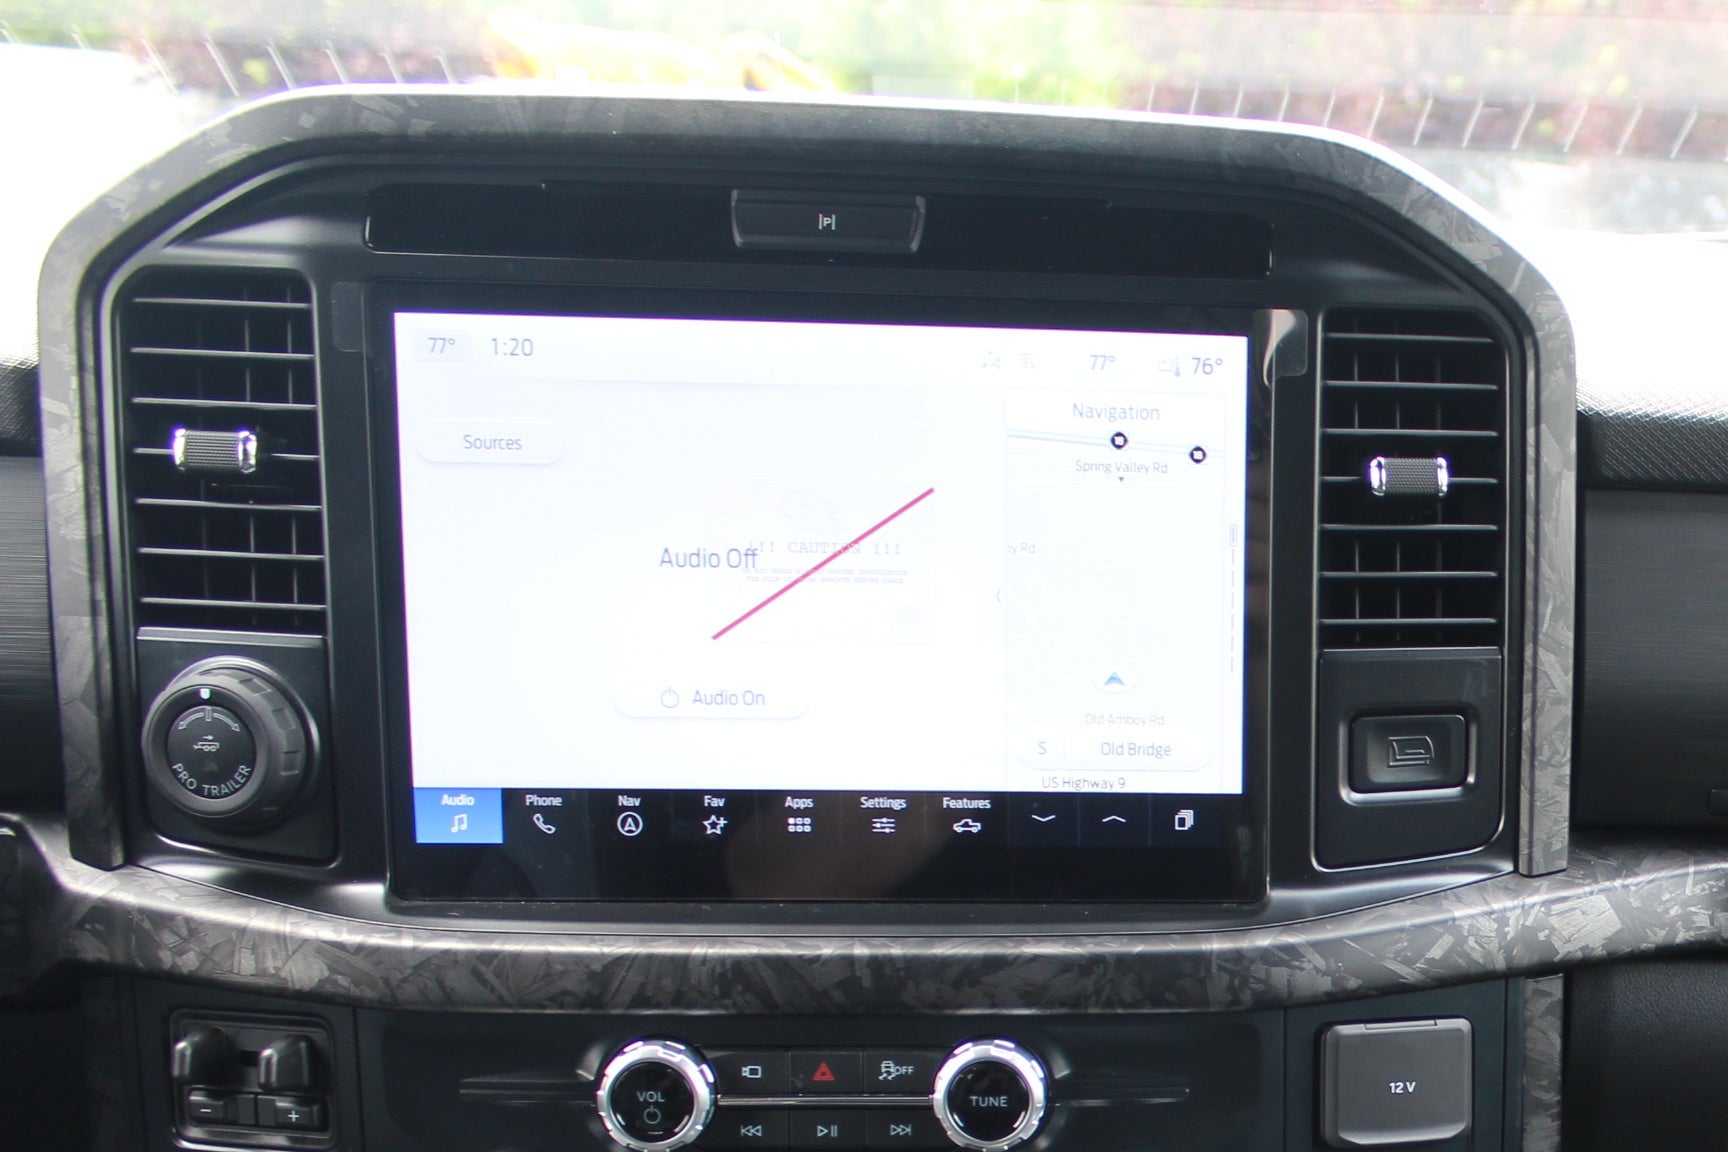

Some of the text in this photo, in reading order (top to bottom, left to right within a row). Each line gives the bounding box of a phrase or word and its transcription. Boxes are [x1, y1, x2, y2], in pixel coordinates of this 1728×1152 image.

[427, 336, 456, 354] 77°
[490, 337, 534, 357] 1:20
[1088, 353, 1116, 371] 77°
[1191, 356, 1223, 376] 76°
[1071, 402, 1161, 422] Navigation
[463, 433, 523, 451] Sources
[1074, 459, 1168, 475] Spring Valley Rd
[659, 547, 759, 569] Audio Off
[692, 689, 766, 706] Audio On
[1084, 713, 1104, 725] Old
[1149, 714, 1165, 726] Rd
[1100, 741, 1173, 760] Old Bridge
[172, 762, 251, 796] PRO TRAILER
[1041, 776, 1126, 792] US Highway 9
[441, 794, 475, 807] Audio
[526, 794, 563, 807] Phone
[618, 795, 641, 807] Nav
[704, 795, 725, 807] Fav
[784, 796, 813, 810] Apps
[860, 796, 907, 811] Settings
[943, 797, 991, 809] Features
[895, 1065, 914, 1075] OFF
[1389, 1081, 1416, 1093] 12 V
[636, 1091, 666, 1102] VOL
[969, 1096, 1008, 1107] TUNE
